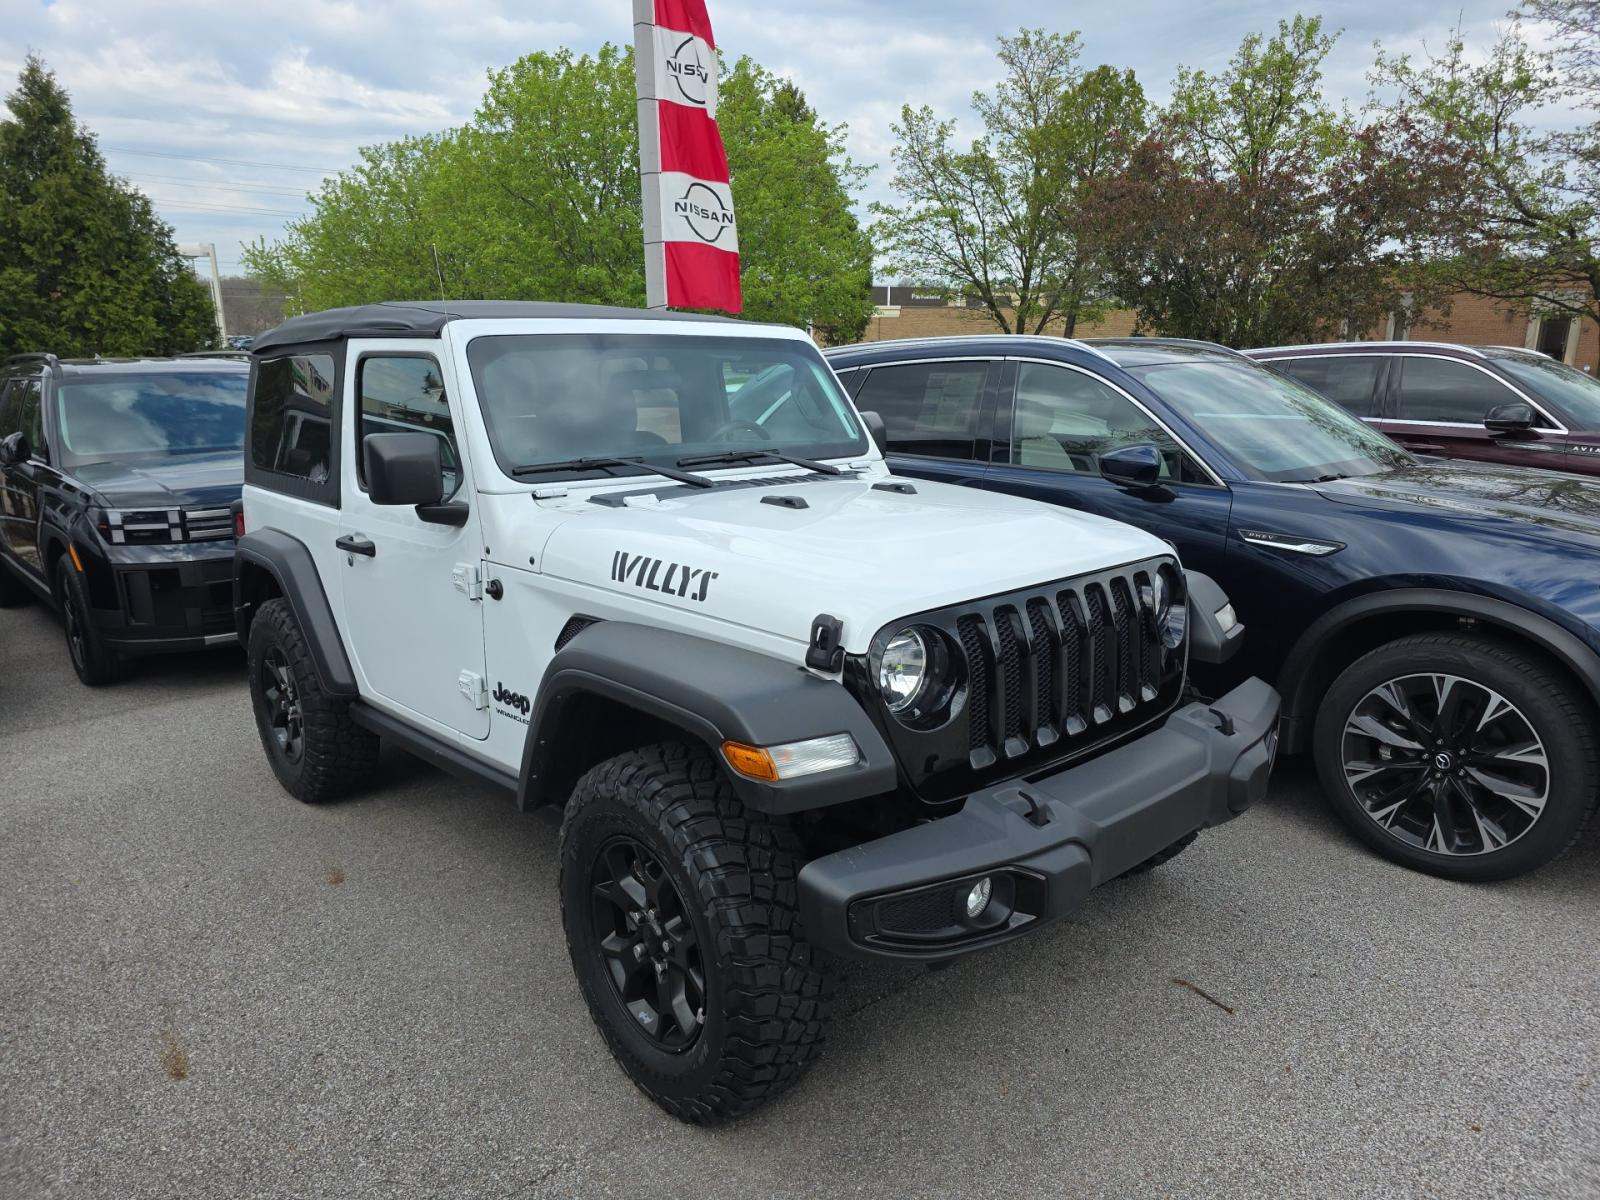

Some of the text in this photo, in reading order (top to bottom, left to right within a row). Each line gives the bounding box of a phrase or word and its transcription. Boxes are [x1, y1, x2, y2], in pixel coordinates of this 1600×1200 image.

[674, 202, 734, 223] NISSAN
[611, 550, 719, 602] WILLYS
[492, 681, 531, 716] Jeep
[495, 707, 531, 726] WRANGLE
